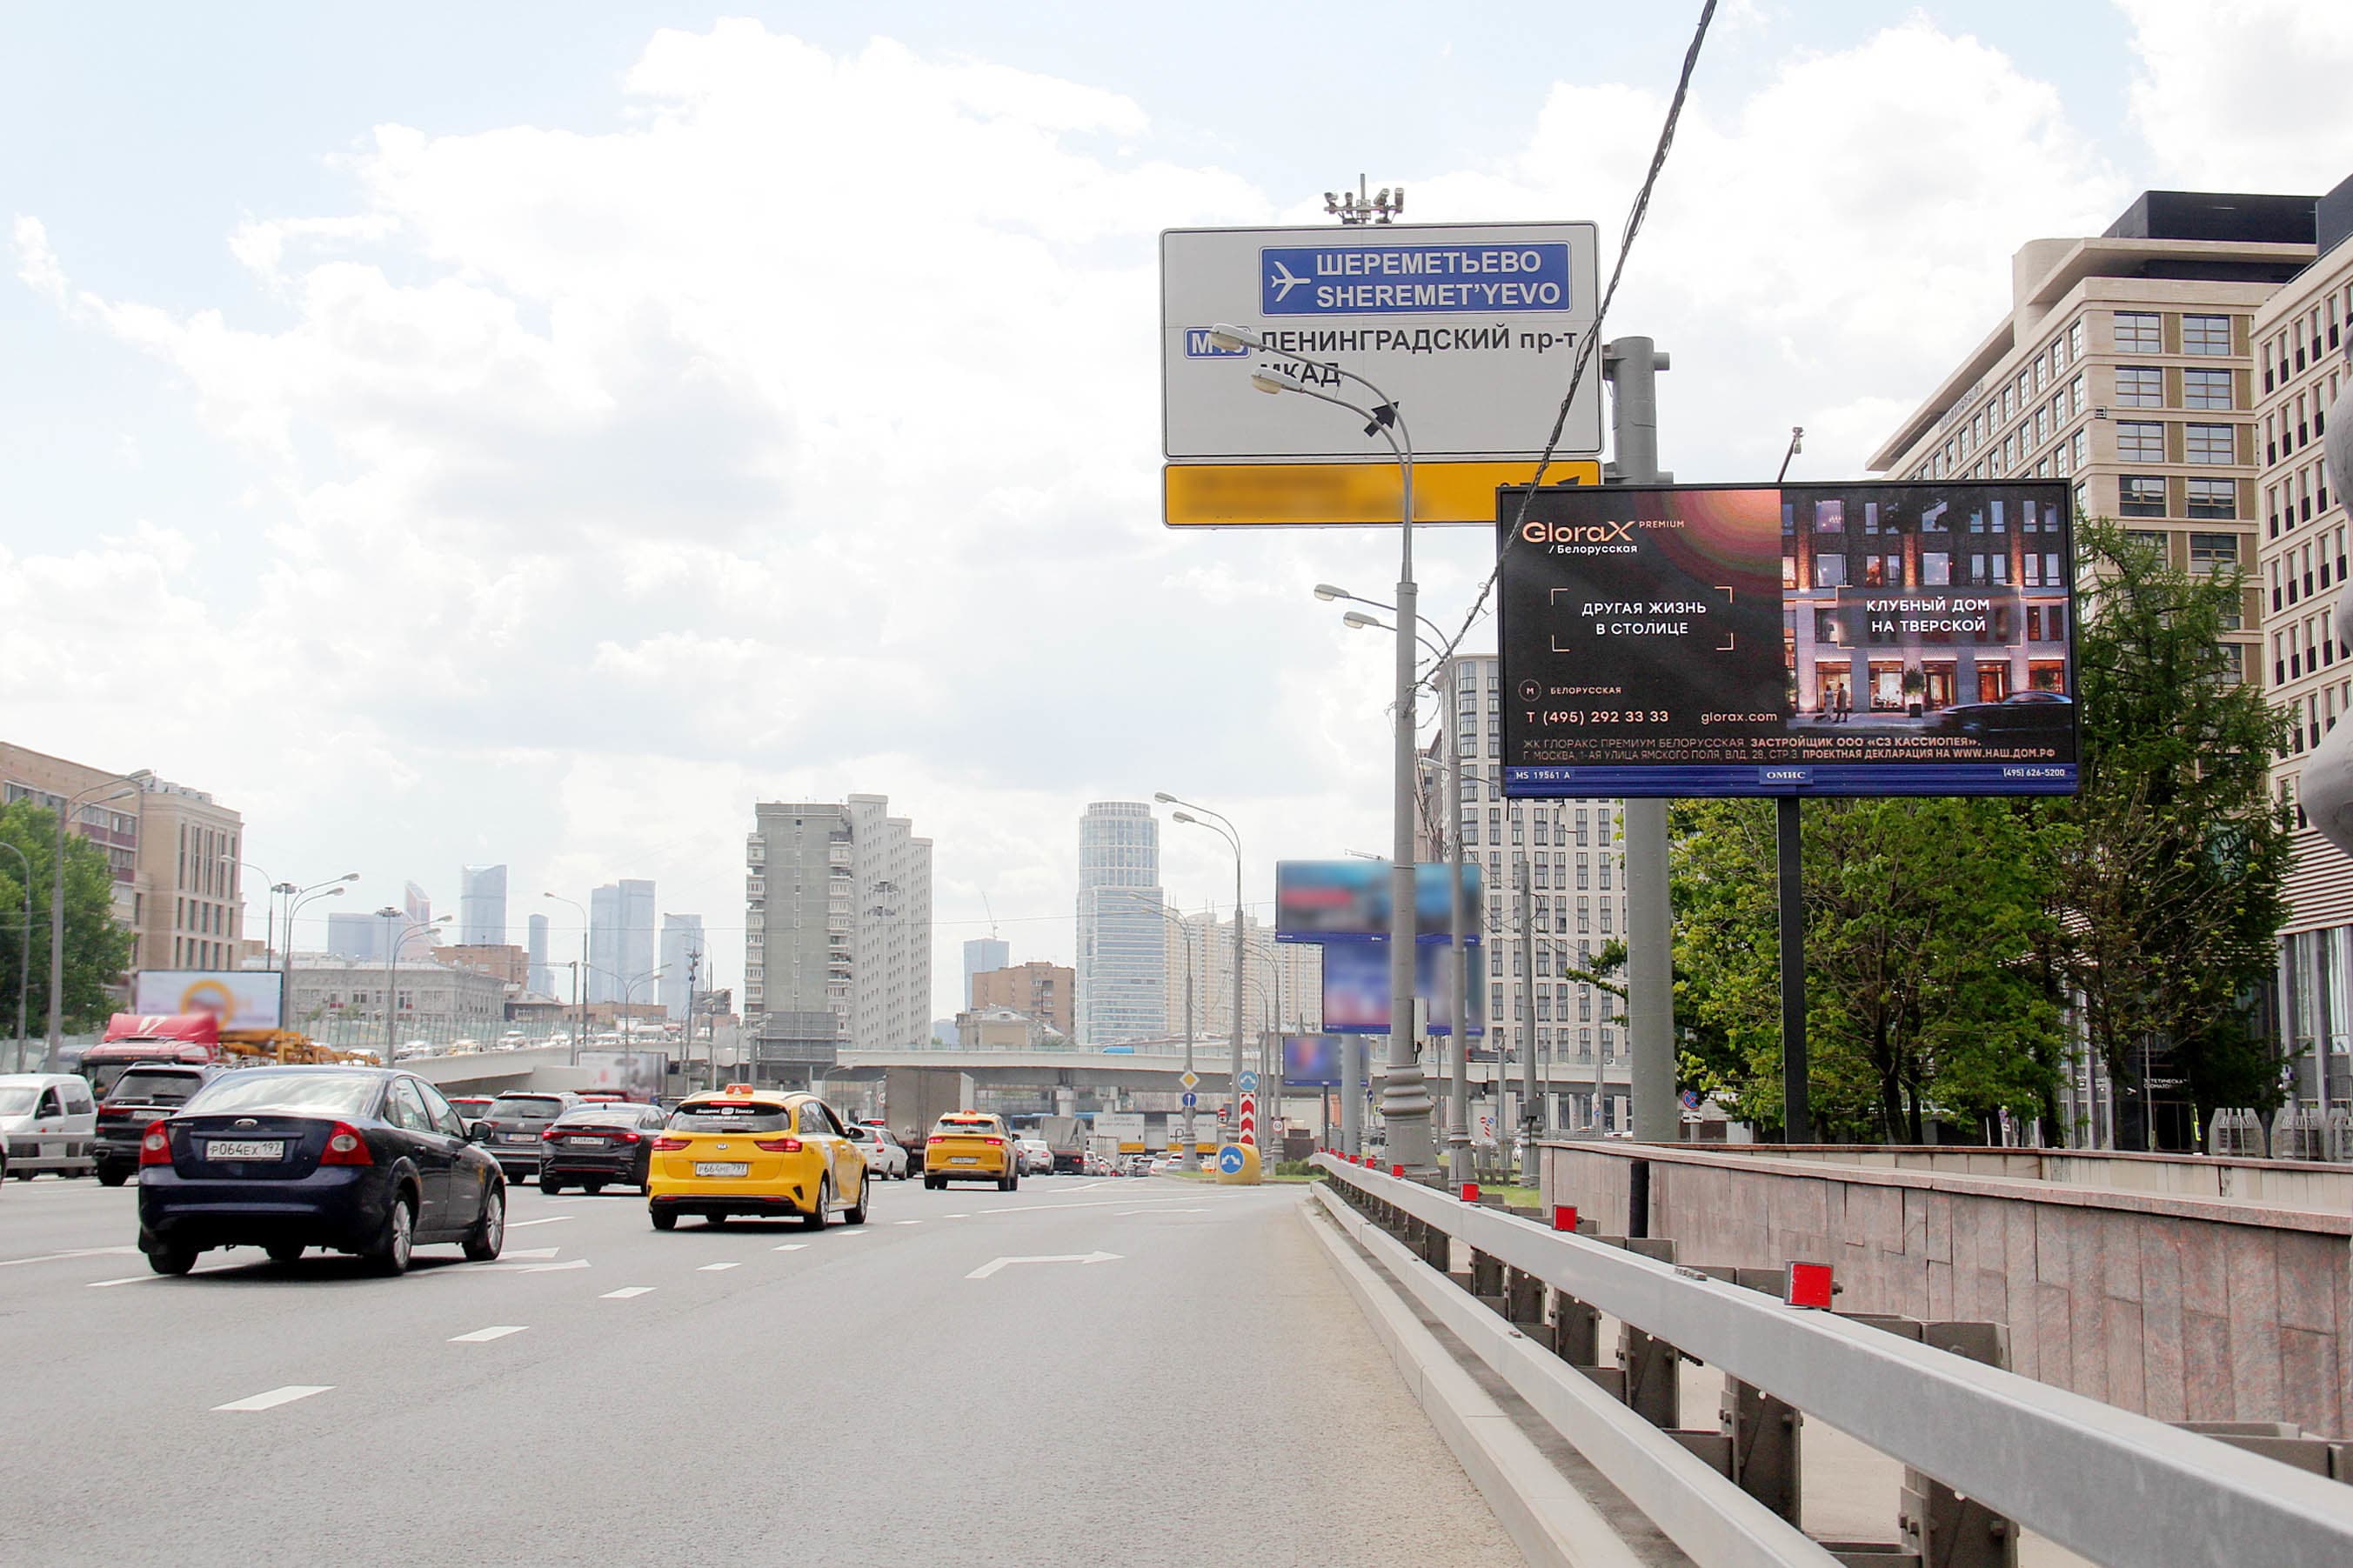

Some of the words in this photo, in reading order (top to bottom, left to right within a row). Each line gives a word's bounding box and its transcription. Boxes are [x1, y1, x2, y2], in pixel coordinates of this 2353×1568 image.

[1316, 250, 1541, 276] ШЕРЕМЕТЬЕВО
[1259, 323, 1510, 352] ЛЕНИНГРАДСКИЙ
[1521, 331, 1577, 354] пр-т
[1260, 363, 1340, 388] КАД
[1522, 520, 1635, 543] GloraX
[1639, 520, 1684, 529] PREMIUM
[1581, 602, 1643, 617] ДРУГАЯ
[1648, 602, 1707, 614] ЖИЗНЬ
[1866, 597, 1946, 611] КЛУБНЫЙ
[1952, 599, 1989, 613] ДОМ
[1596, 624, 1606, 635] В
[1611, 623, 1688, 637] СТОЛИЦЕ
[1871, 621, 1895, 632] НА
[1900, 617, 1986, 632] ТВЕРСКОЙ
[1543, 711, 1585, 725] (495)
[1591, 711, 1619, 723] 292
[1625, 711, 1644, 722] 33
[1650, 711, 1668, 722] 33
[1701, 711, 1777, 724] glorax.com
[1523, 739, 1541, 748] ЖК
[1544, 739, 1597, 749] ГЛОРАКС
[1601, 739, 1655, 748] ПРЕМИУМ
[1751, 736, 1832, 748] ЗАСТРОЙЩИК
[1836, 737, 1863, 746] ООО
[1605, 751, 1638, 760] УЛИЦА
[1641, 751, 1688, 759] ЯМСКОГО
[1802, 750, 1862, 758] ПРОЕКТНАЯ
[1864, 749, 1933, 759] ДЕКЛАРАЦИЯ
[1935, 749, 1949, 757] НА
[2003, 768, 2024, 777] (495)
